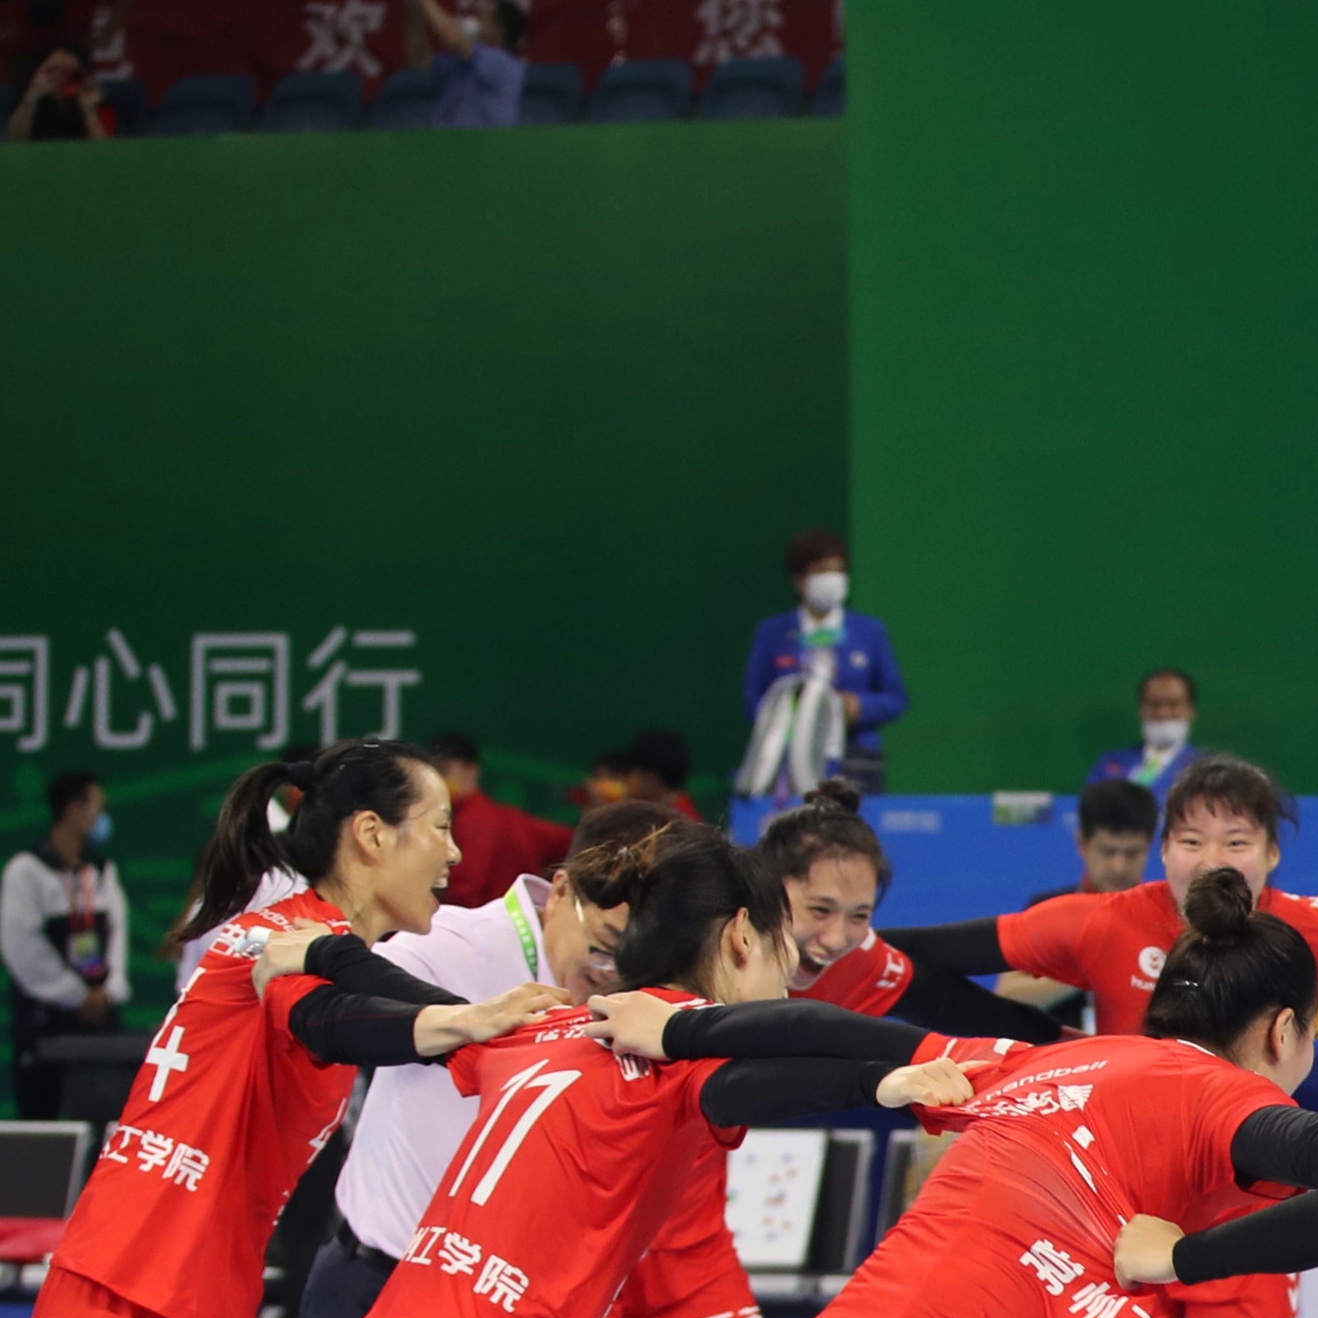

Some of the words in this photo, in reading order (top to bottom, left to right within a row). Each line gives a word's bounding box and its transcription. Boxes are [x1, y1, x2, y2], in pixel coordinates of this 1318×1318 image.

[99, 1123, 211, 1192] 工学院
[448, 1058, 583, 1207] 17
